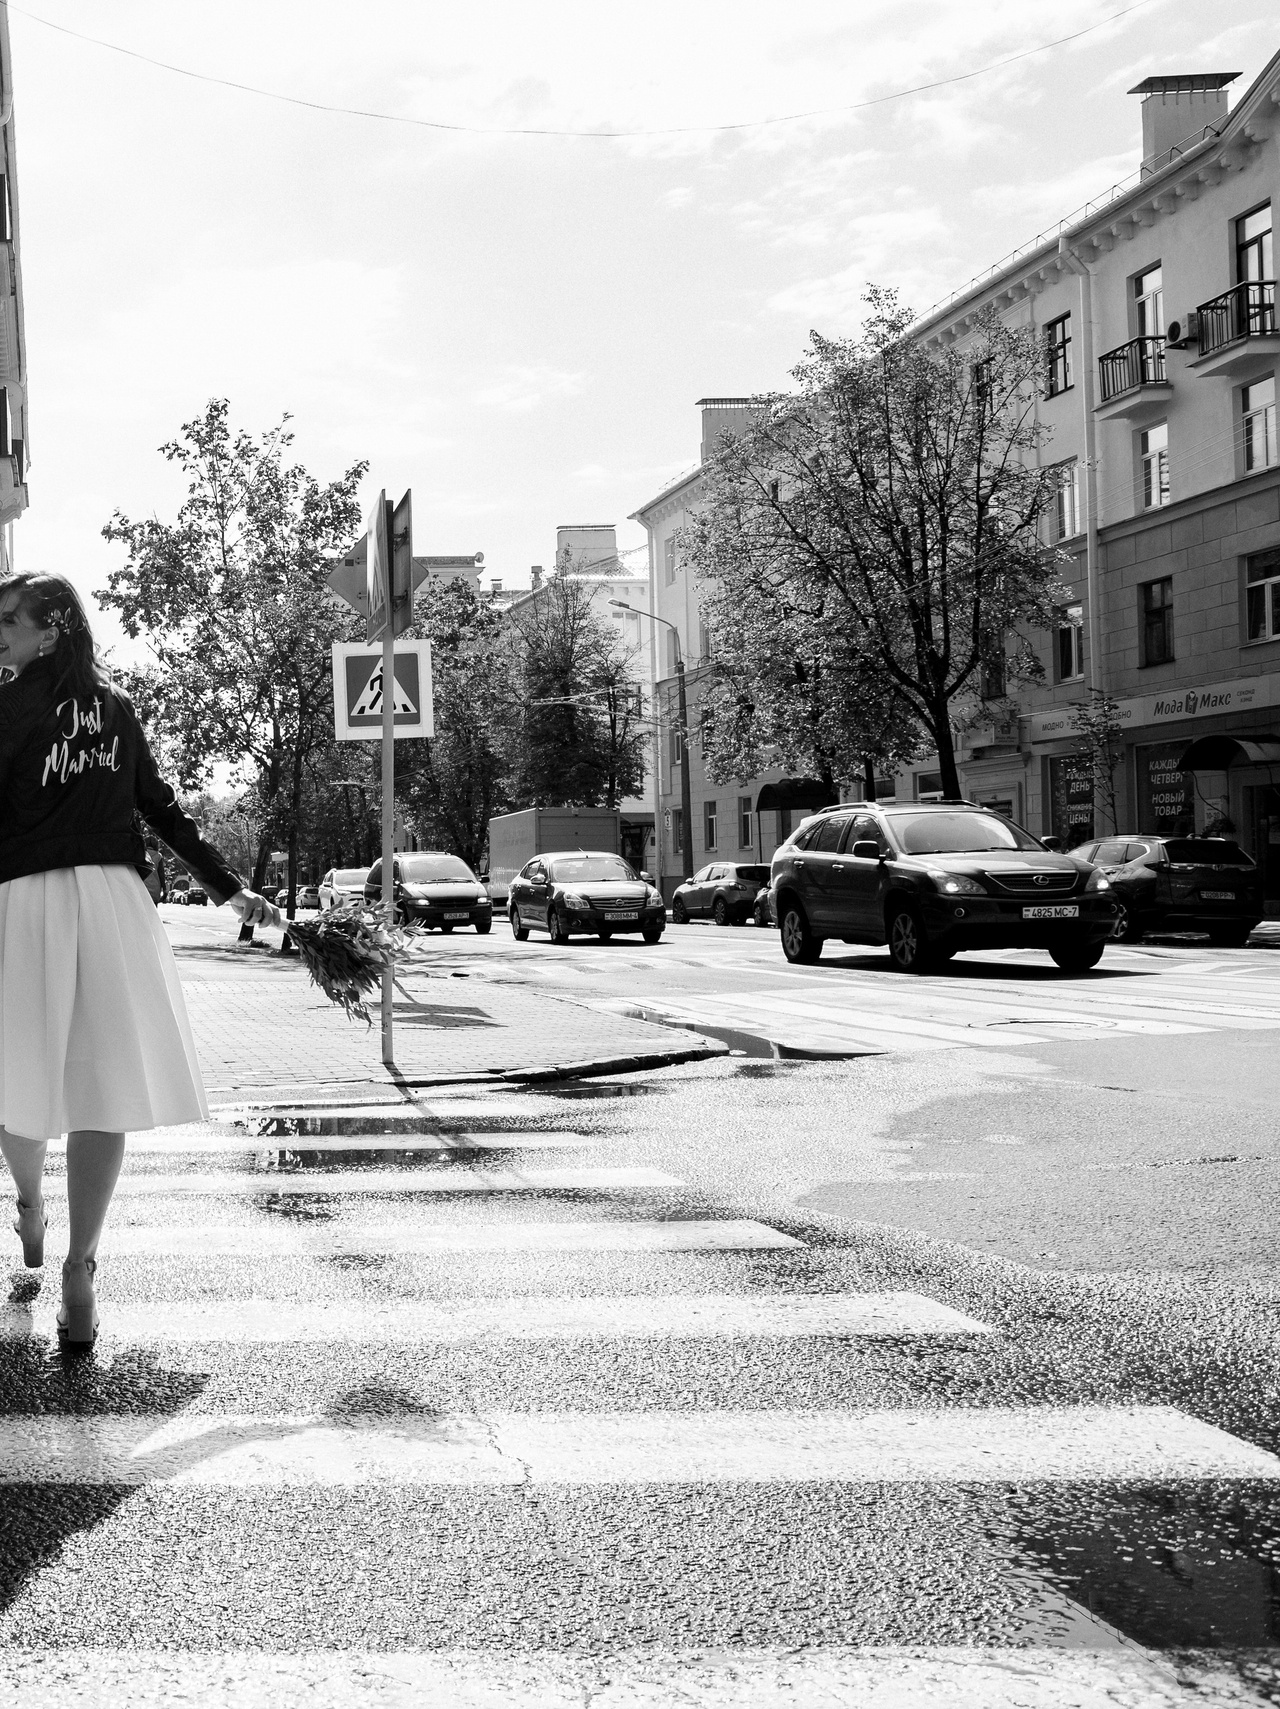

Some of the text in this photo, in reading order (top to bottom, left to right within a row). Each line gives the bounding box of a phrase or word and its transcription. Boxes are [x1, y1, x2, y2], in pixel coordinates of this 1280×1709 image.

[1153, 693, 1232, 716] Мода Макс
[56, 695, 104, 740] Just
[1042, 721, 1064, 731] МОДНО
[41, 735, 121, 787] Married
[1149, 758, 1180, 771] КАЖДЫ
[1070, 781, 1090, 794] ДЕНЬ
[1152, 789, 1185, 804] НОВЫЙ
[1154, 805, 1183, 817] ТОВАР
[1069, 813, 1091, 825] ЦЕНЫ
[1032, 908, 1053, 918] 4825
[1054, 907, 1078, 917] MC-7
